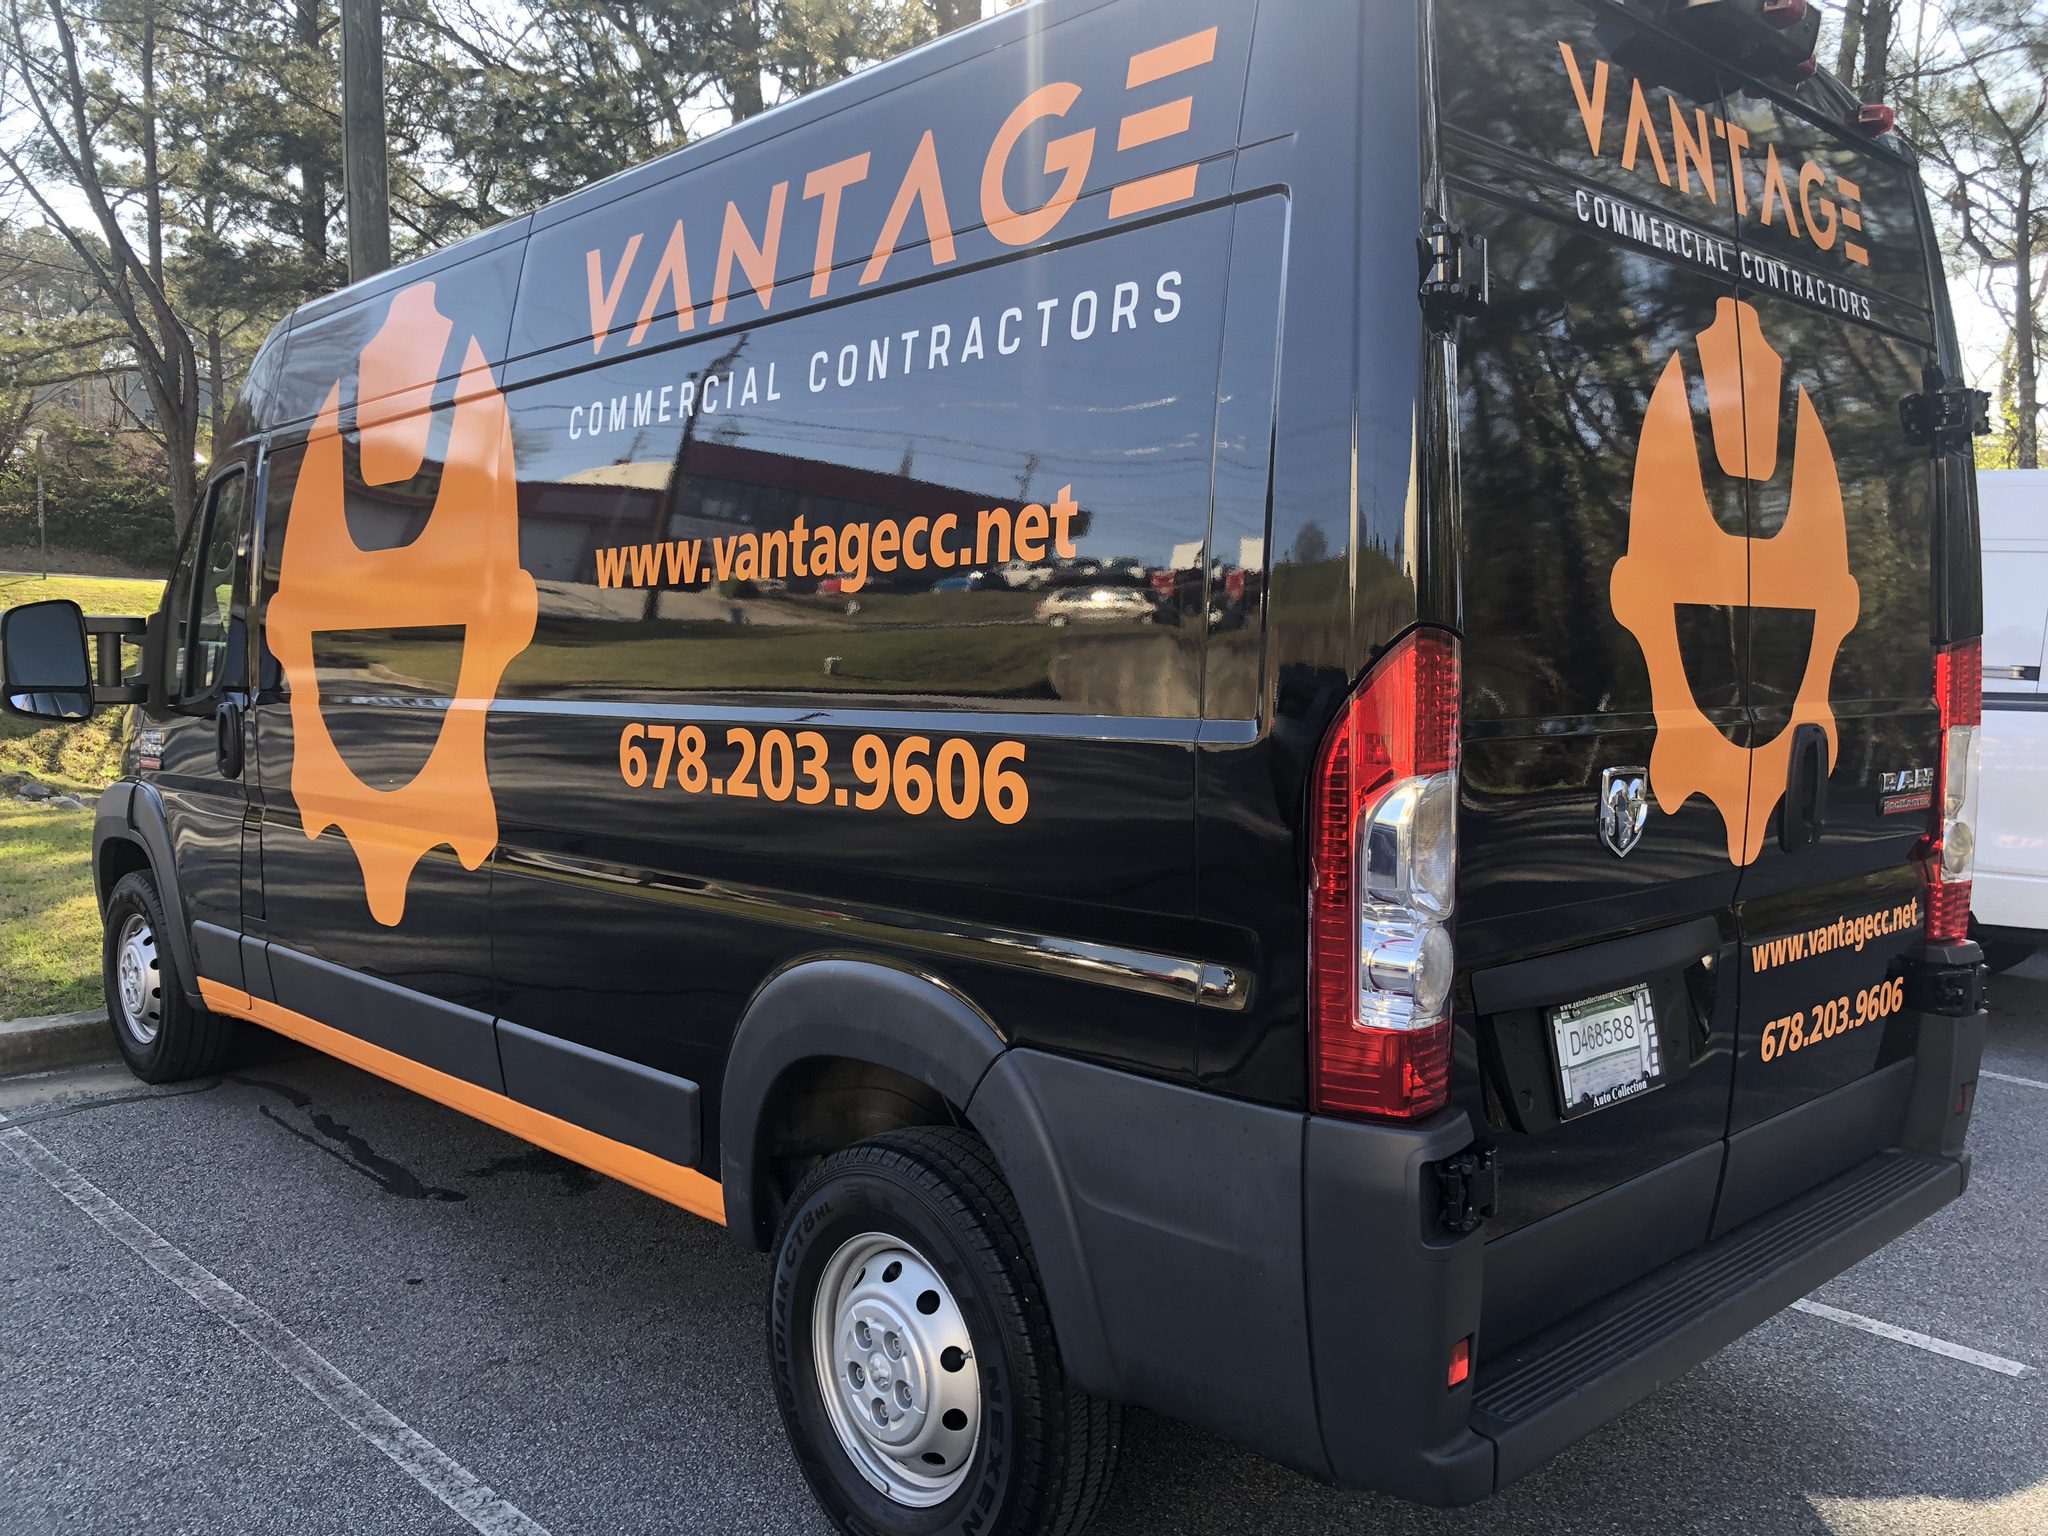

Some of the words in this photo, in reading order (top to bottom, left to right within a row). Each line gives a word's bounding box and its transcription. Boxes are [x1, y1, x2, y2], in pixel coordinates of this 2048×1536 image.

[585, 26, 1218, 355] VANTAGE
[1558, 40, 1869, 266] VANTAGE
[1574, 190, 1729, 272] COMMERCIAL
[1740, 251, 1871, 321] CONTRACTORS
[568, 362, 781, 440] COMMERCIAL
[808, 270, 1182, 393] CONTRACTORS
[595, 484, 1079, 593] www.vantagecc.net
[618, 722, 1030, 825] 678.203.9606
[1752, 896, 1917, 973] www.vantagecc.net
[1569, 1015, 1635, 1057] D468588
[1761, 976, 1904, 1062] 678.203.9606
[1593, 1090, 1612, 1108] Auto
[1612, 1078, 1648, 1100] Collection
